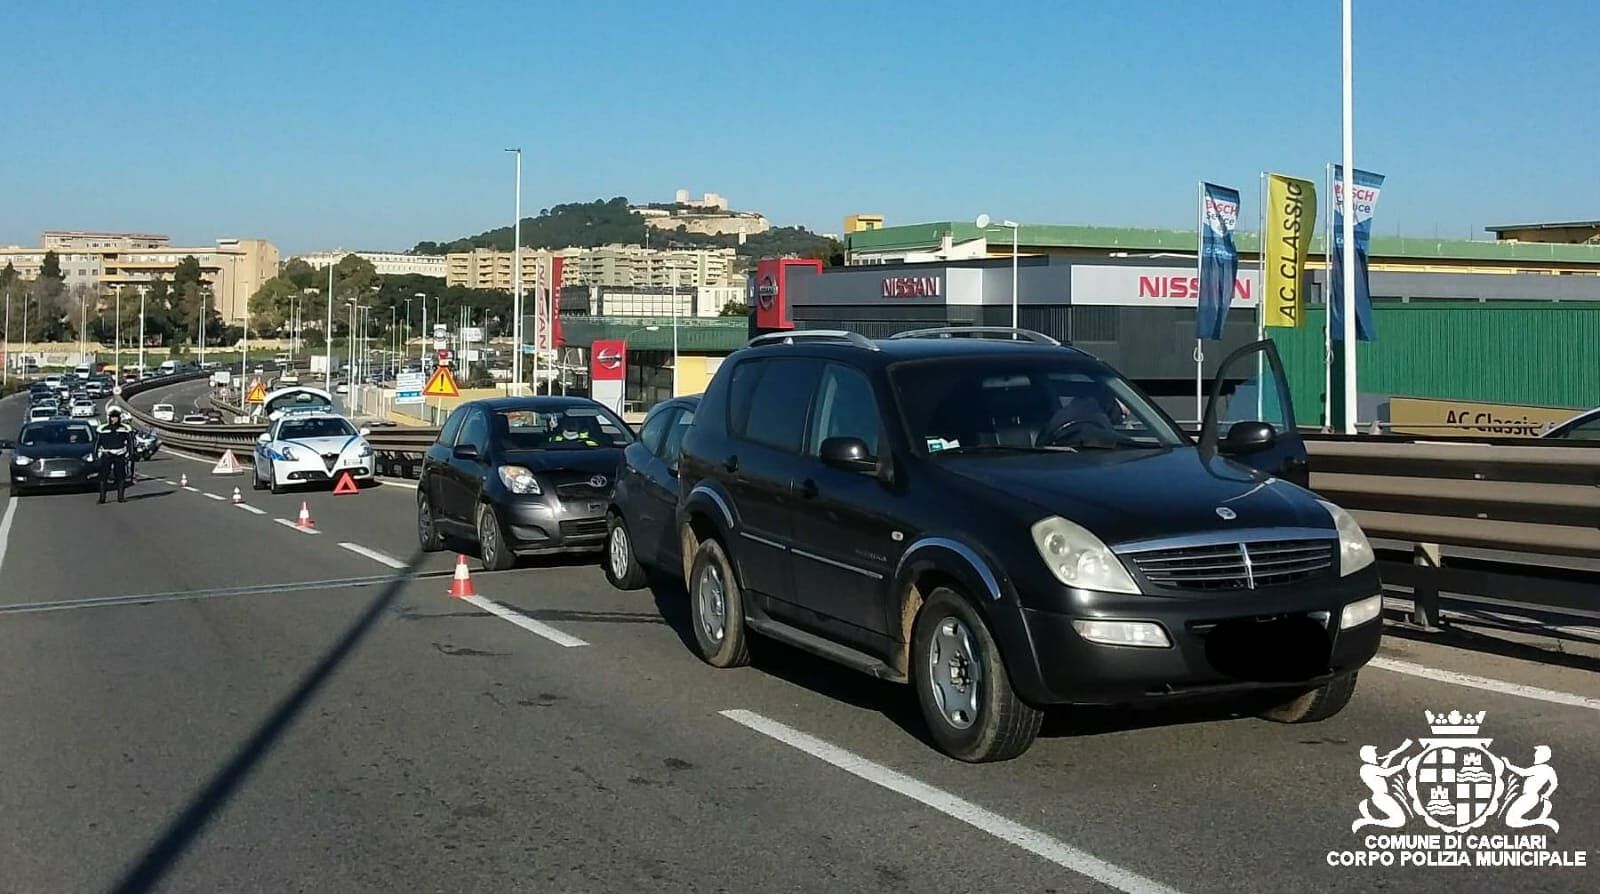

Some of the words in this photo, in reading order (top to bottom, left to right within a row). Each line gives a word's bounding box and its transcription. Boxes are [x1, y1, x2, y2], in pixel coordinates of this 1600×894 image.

[1334, 182, 1375, 202] BSCH
[1279, 181, 1303, 280] CLASSIC
[882, 276, 941, 297] NISSAN
[1138, 275, 1251, 299] NISSN
[1279, 286, 1297, 321] AC
[1446, 410, 1470, 429] AC
